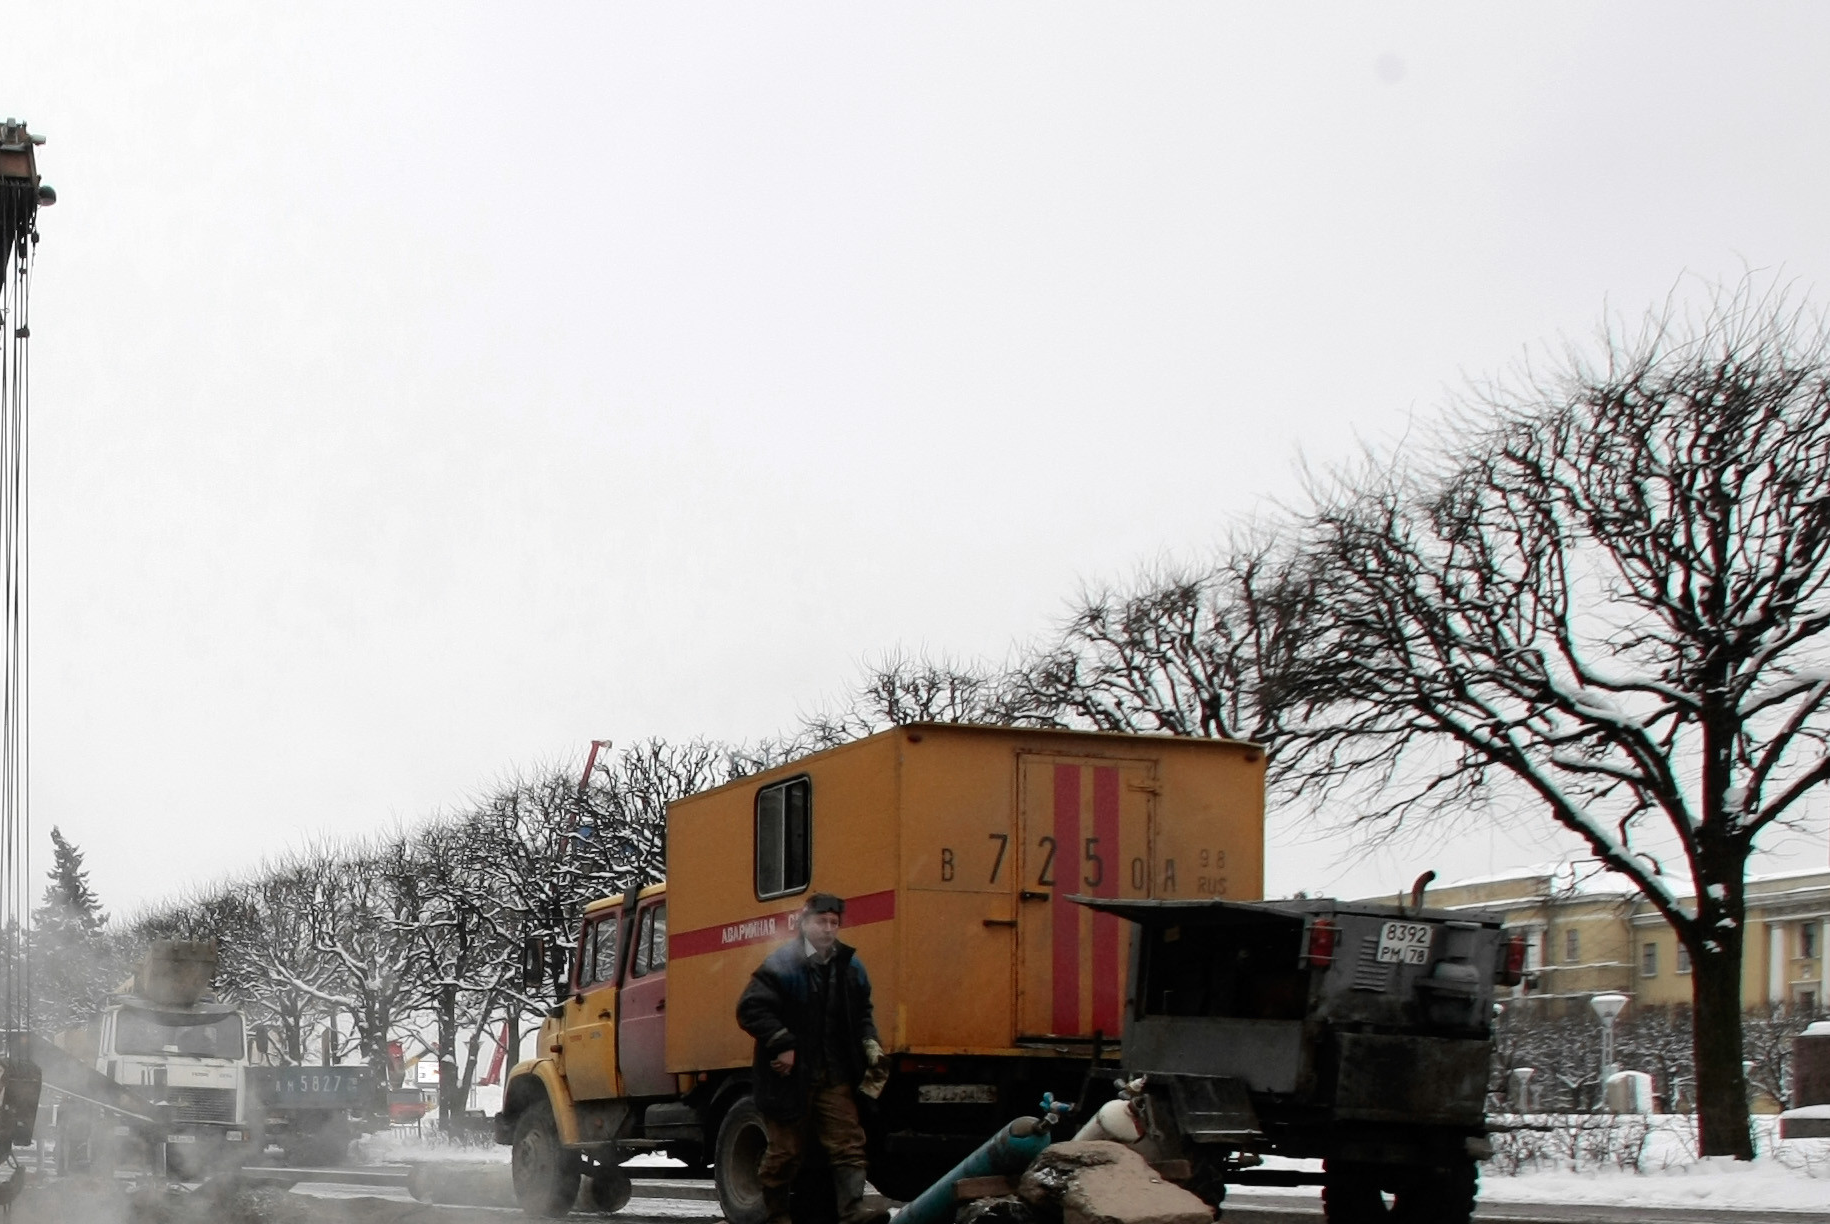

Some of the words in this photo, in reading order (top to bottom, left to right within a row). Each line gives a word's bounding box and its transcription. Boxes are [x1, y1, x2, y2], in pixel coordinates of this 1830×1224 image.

[1197, 876, 1227, 895] RUS
[1386, 924, 1427, 943] 8392
[1410, 949, 1425, 962] 78
